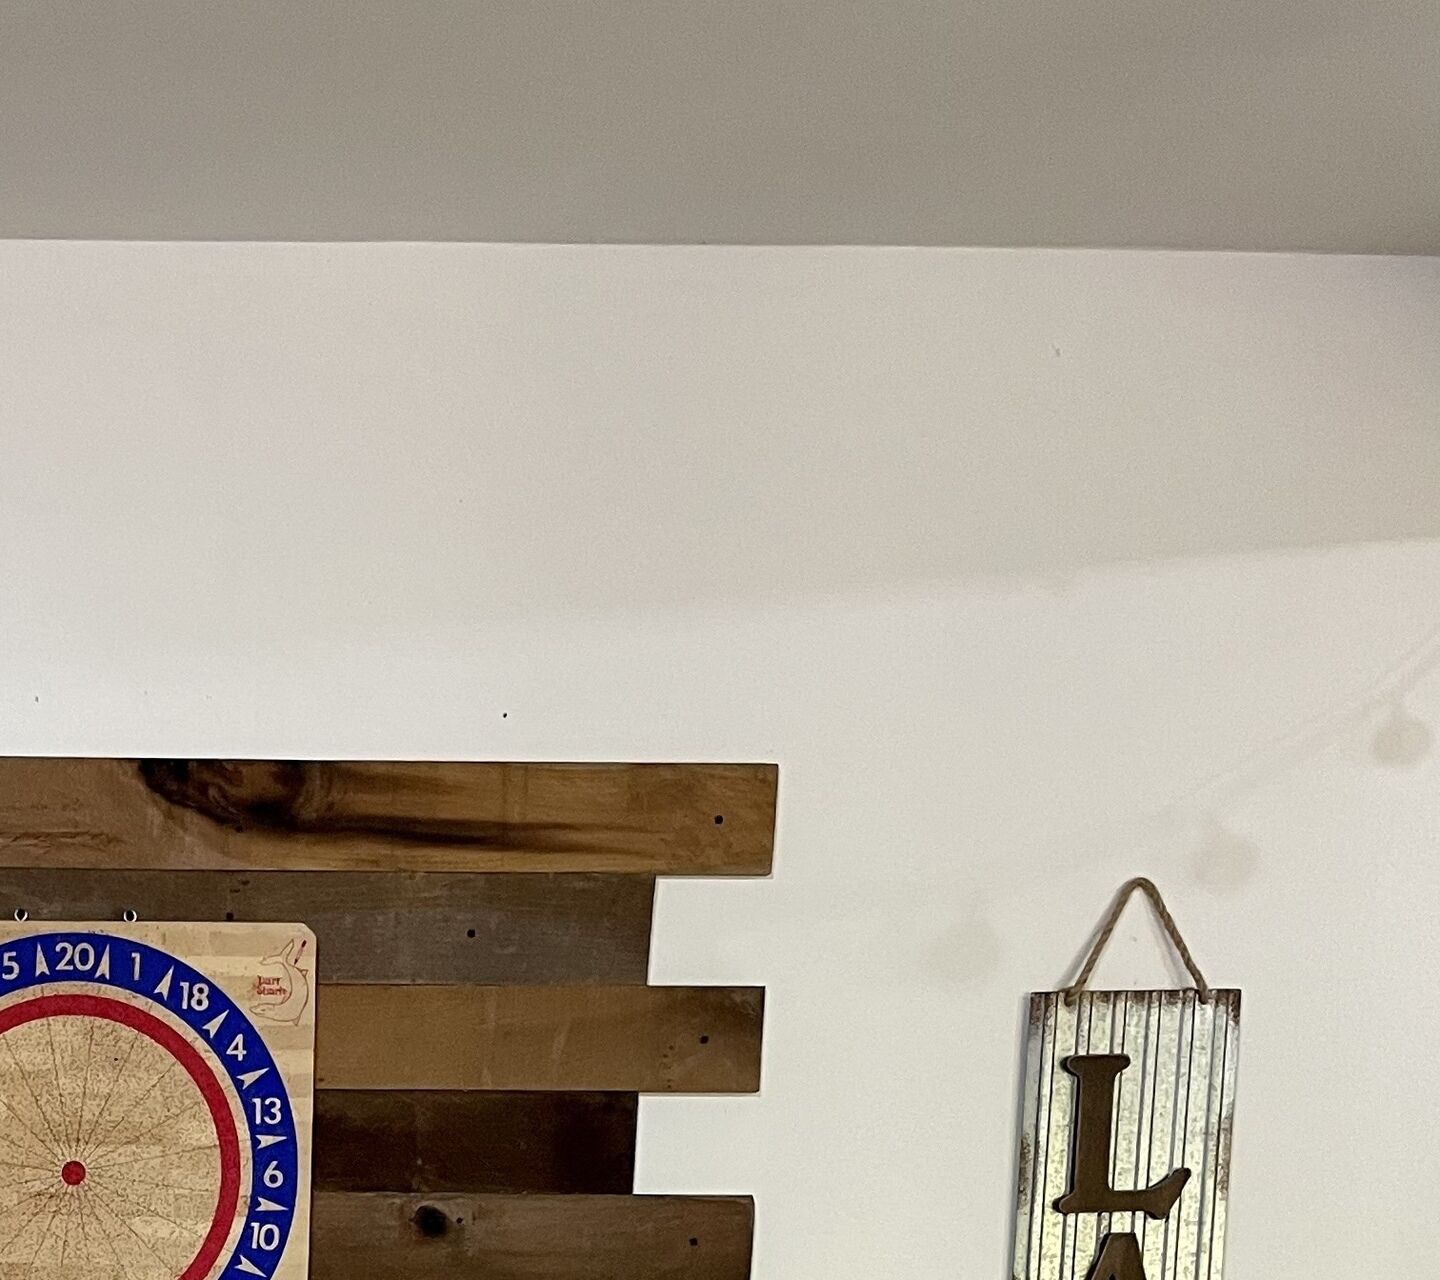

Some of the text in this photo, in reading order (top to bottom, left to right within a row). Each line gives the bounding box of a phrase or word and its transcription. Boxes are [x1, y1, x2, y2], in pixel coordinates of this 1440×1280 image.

[1, 951, 20, 980] 5
[55, 942, 95, 971] 20
[131, 952, 141, 981] 1
[179, 981, 210, 1012] 18
[225, 1033, 247, 1062] 4
[251, 1097, 282, 1125] 13
[263, 1160, 284, 1189] 6
[250, 1221, 280, 1251] 10
